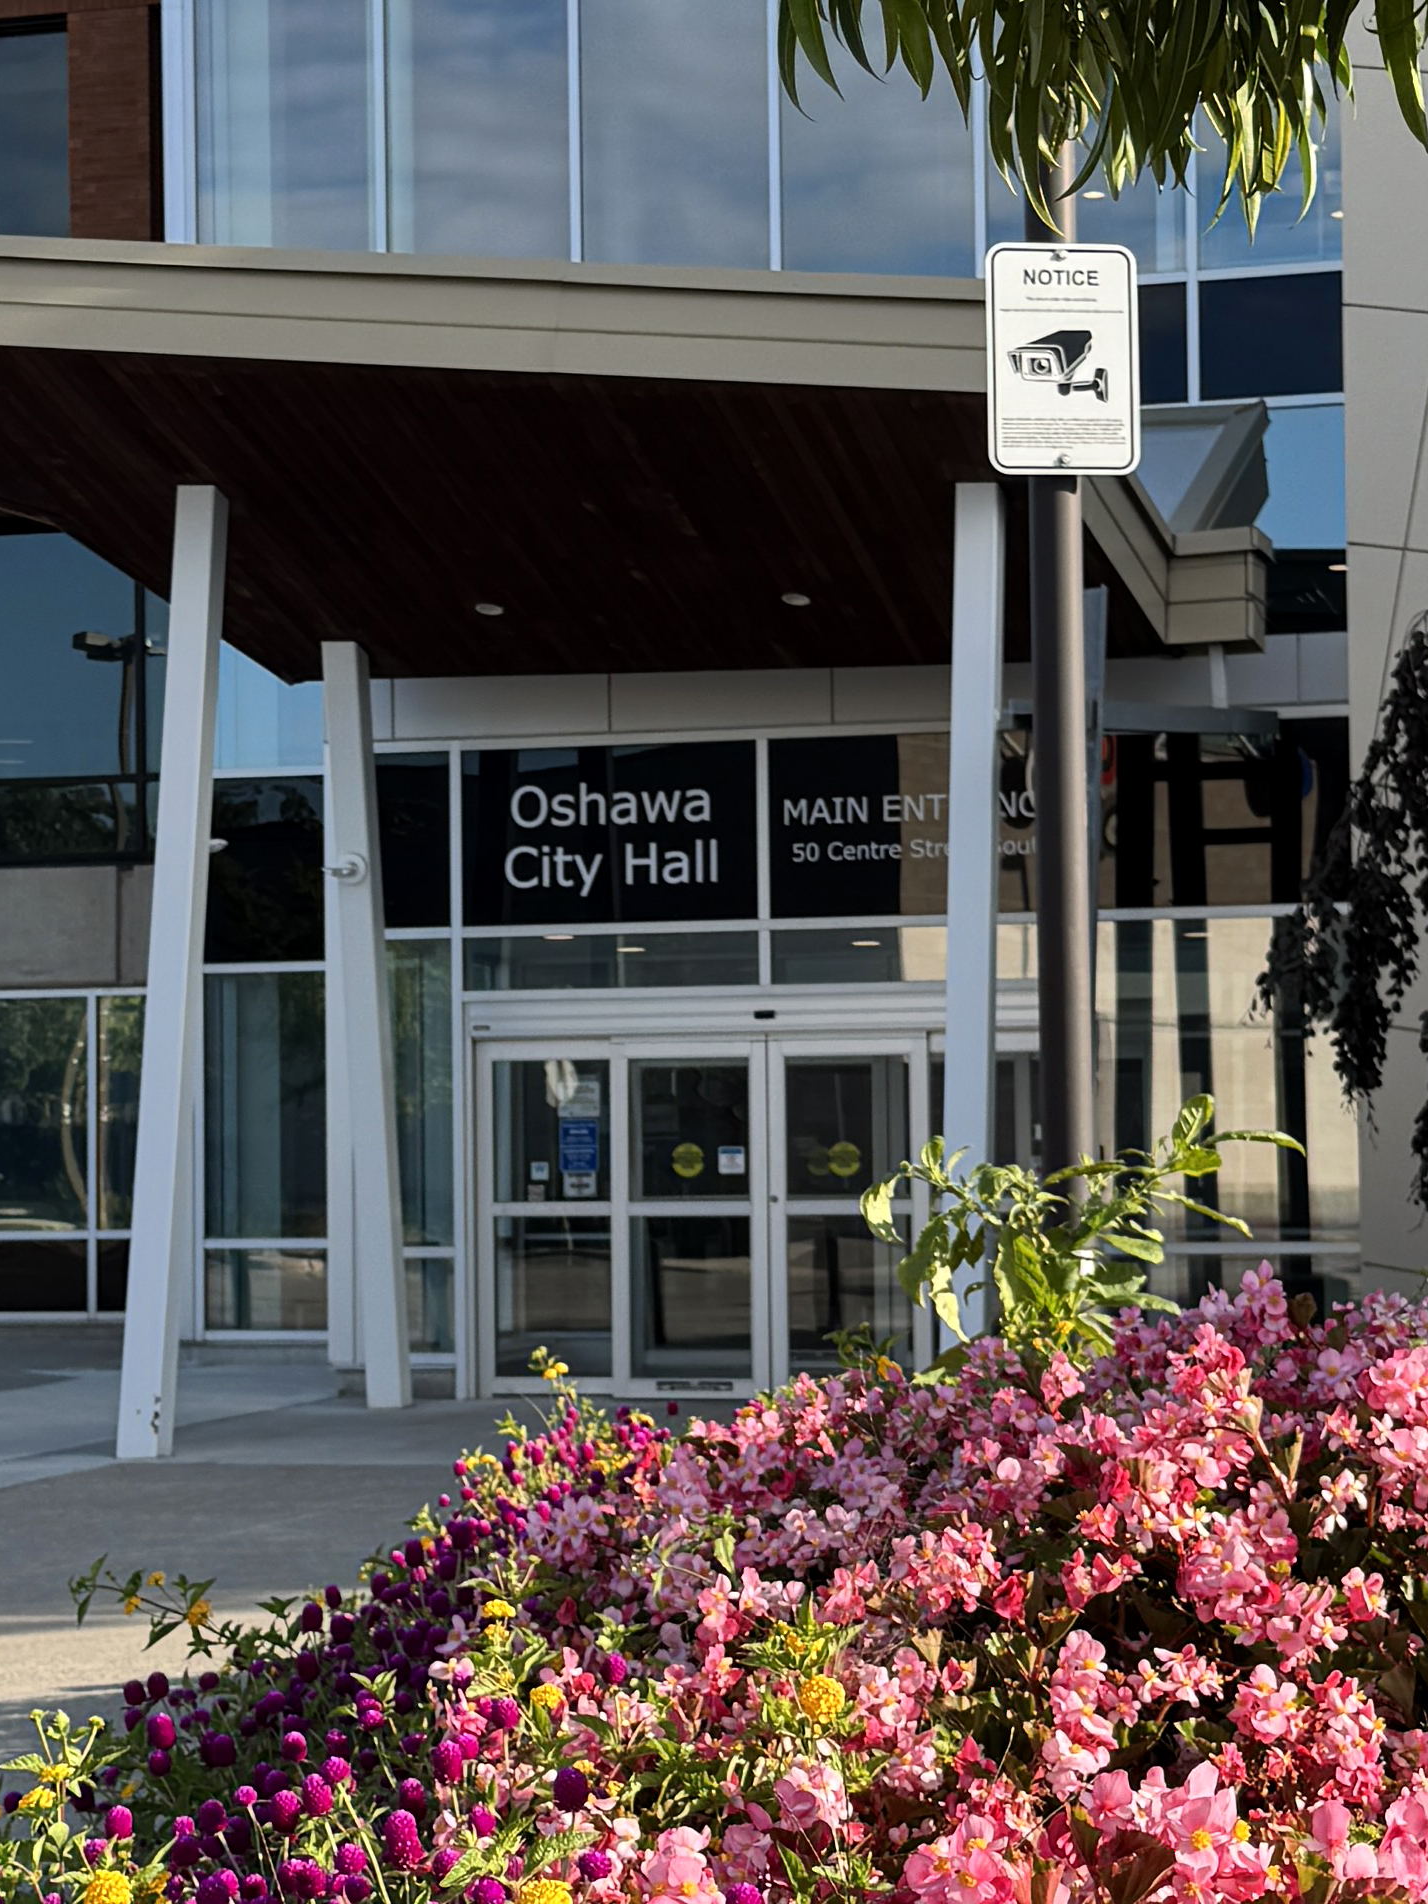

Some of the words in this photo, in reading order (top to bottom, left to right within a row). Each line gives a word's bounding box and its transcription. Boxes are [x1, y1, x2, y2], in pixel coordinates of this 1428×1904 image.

[1023, 269, 1099, 286] NOTICE
[510, 782, 711, 829] Oshawa
[783, 796, 870, 826] MAIN
[882, 790, 1036, 823] ENTNC
[504, 845, 603, 897] City
[625, 838, 718, 885] Hall
[792, 843, 820, 863] 50
[827, 840, 902, 862] Centre
[910, 838, 949, 859] Str
